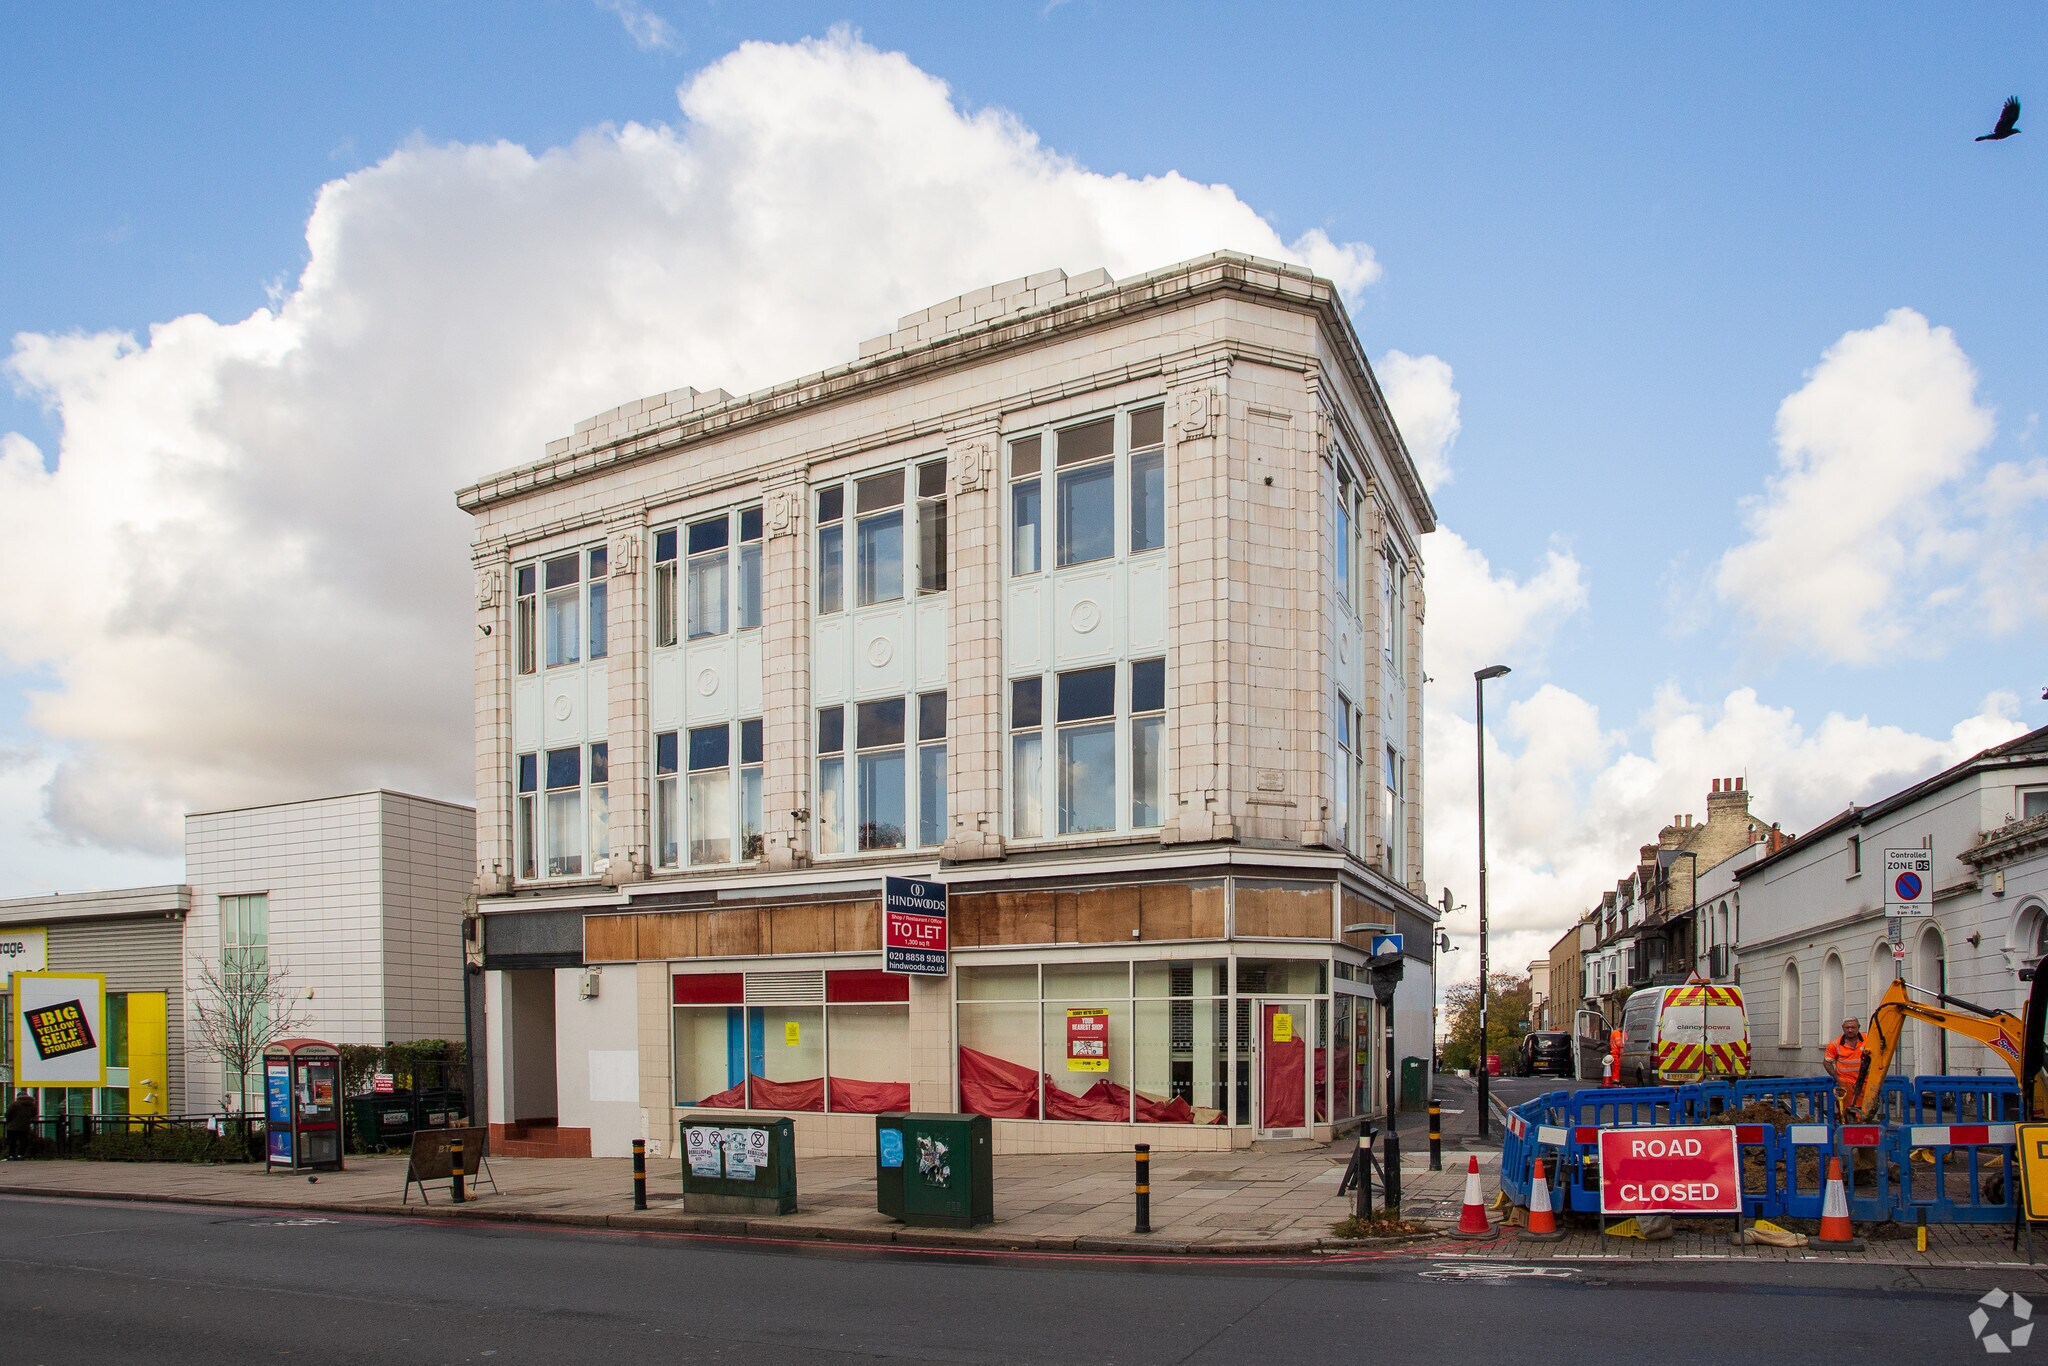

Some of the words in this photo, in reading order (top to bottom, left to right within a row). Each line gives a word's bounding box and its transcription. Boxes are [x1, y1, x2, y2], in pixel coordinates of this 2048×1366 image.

[888, 895, 945, 910] HINDWOODS
[892, 922, 912, 936] TO
[916, 924, 941, 939] LET
[889, 952, 903, 960] 020
[926, 954, 945, 963] 9303
[889, 962, 944, 972] hindwoods.co.uk
[40, 1006, 79, 1026] BIG
[37, 1020, 76, 1035] YELLOW
[41, 1028, 78, 1046] SELF
[44, 1039, 83, 1054] STORAGE
[1632, 1139, 1702, 1158] ROAD
[1620, 1183, 1719, 1202] CLOSED
